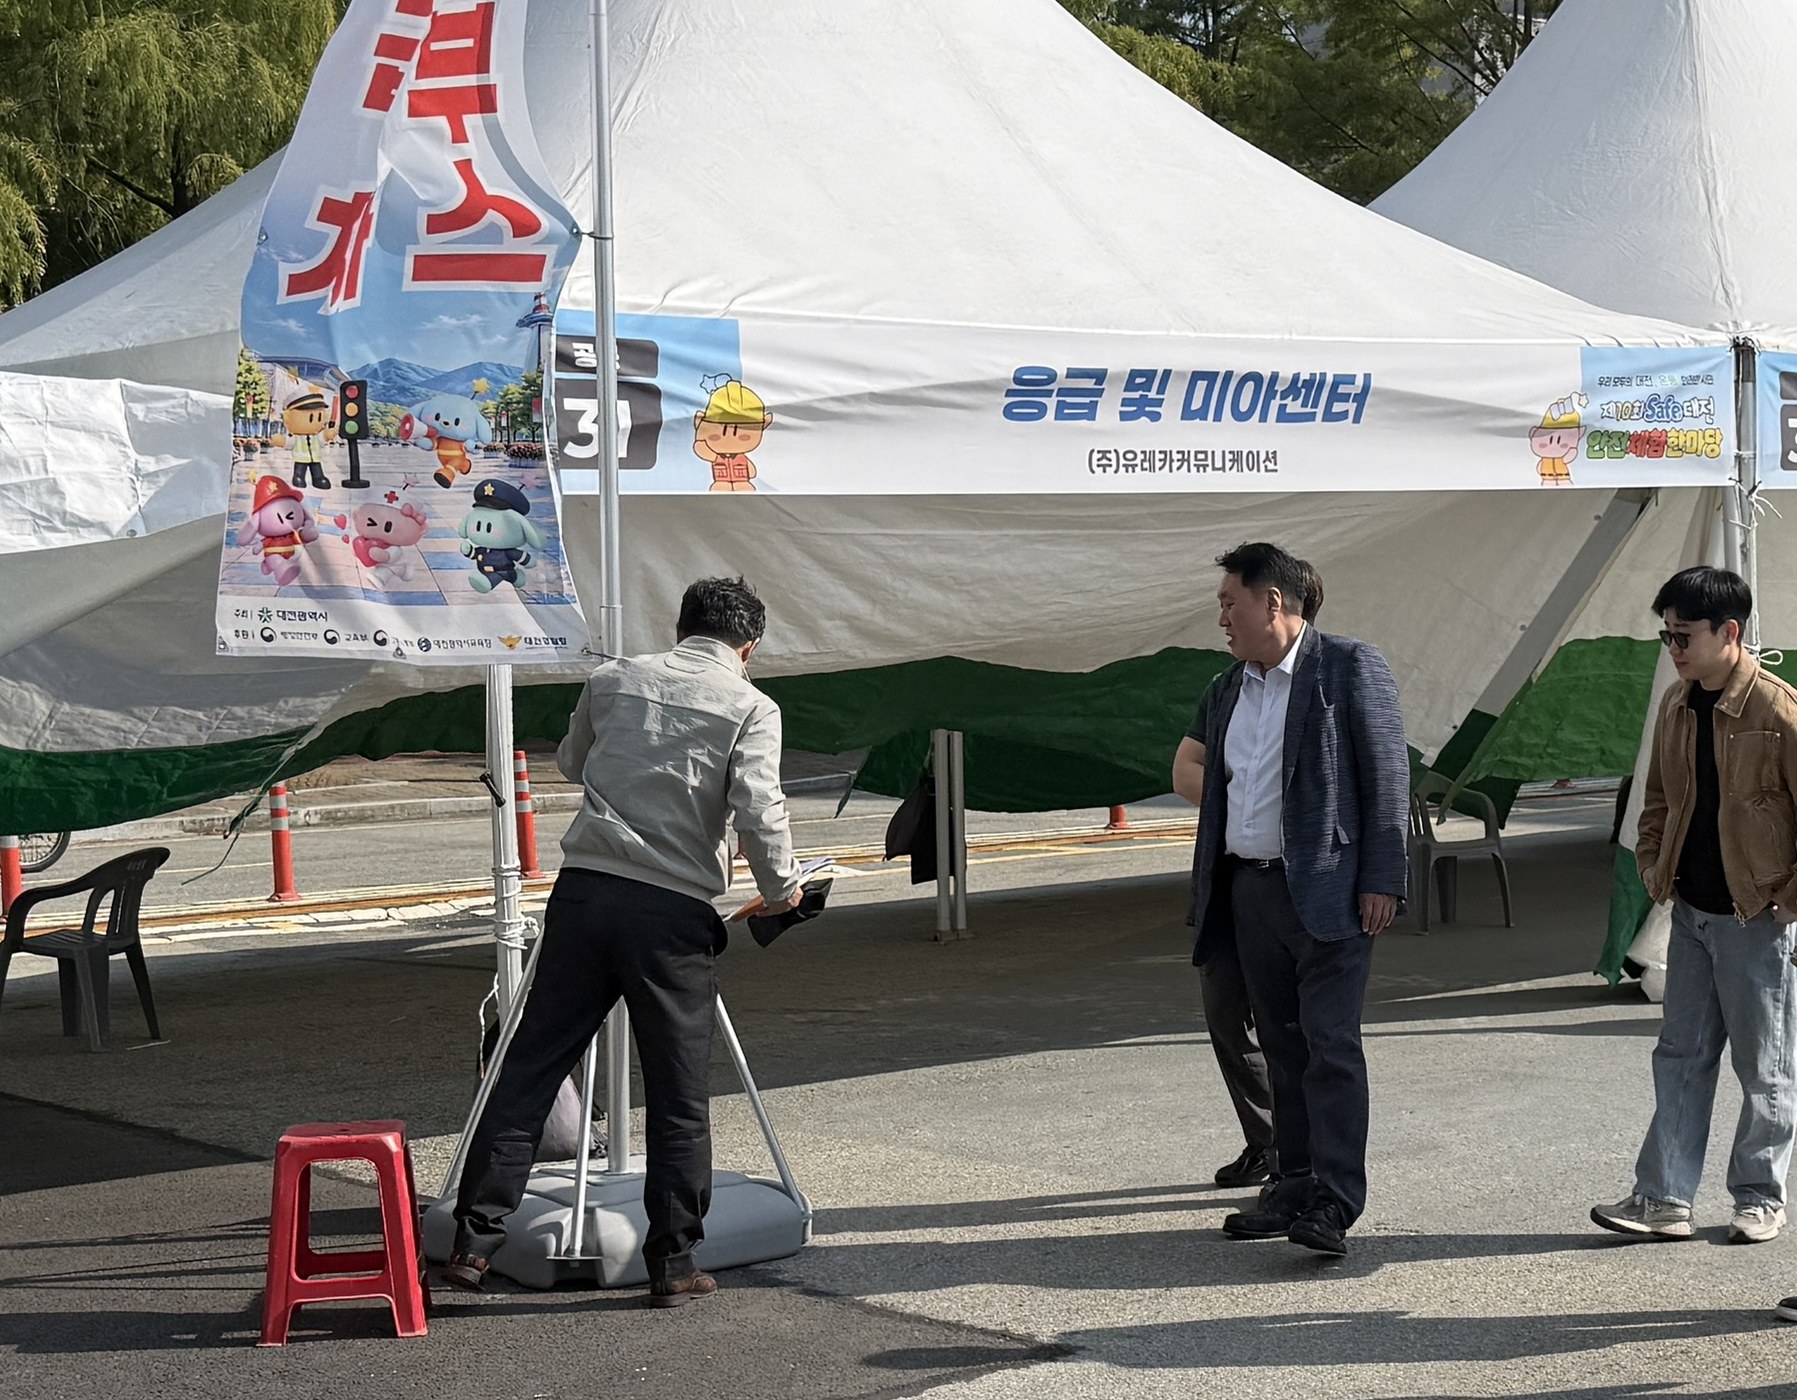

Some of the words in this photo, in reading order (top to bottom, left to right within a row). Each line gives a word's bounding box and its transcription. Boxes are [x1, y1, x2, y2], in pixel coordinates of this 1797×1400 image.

[1002, 365, 1108, 422] 응급
[1118, 368, 1172, 423] 및
[1180, 370, 1373, 425] 미아센터
[563, 398, 632, 459] 31
[1088, 449, 1278, 474] (주)유레카커뮤니케이션
[276, 609, 328, 622] 대전광역시
